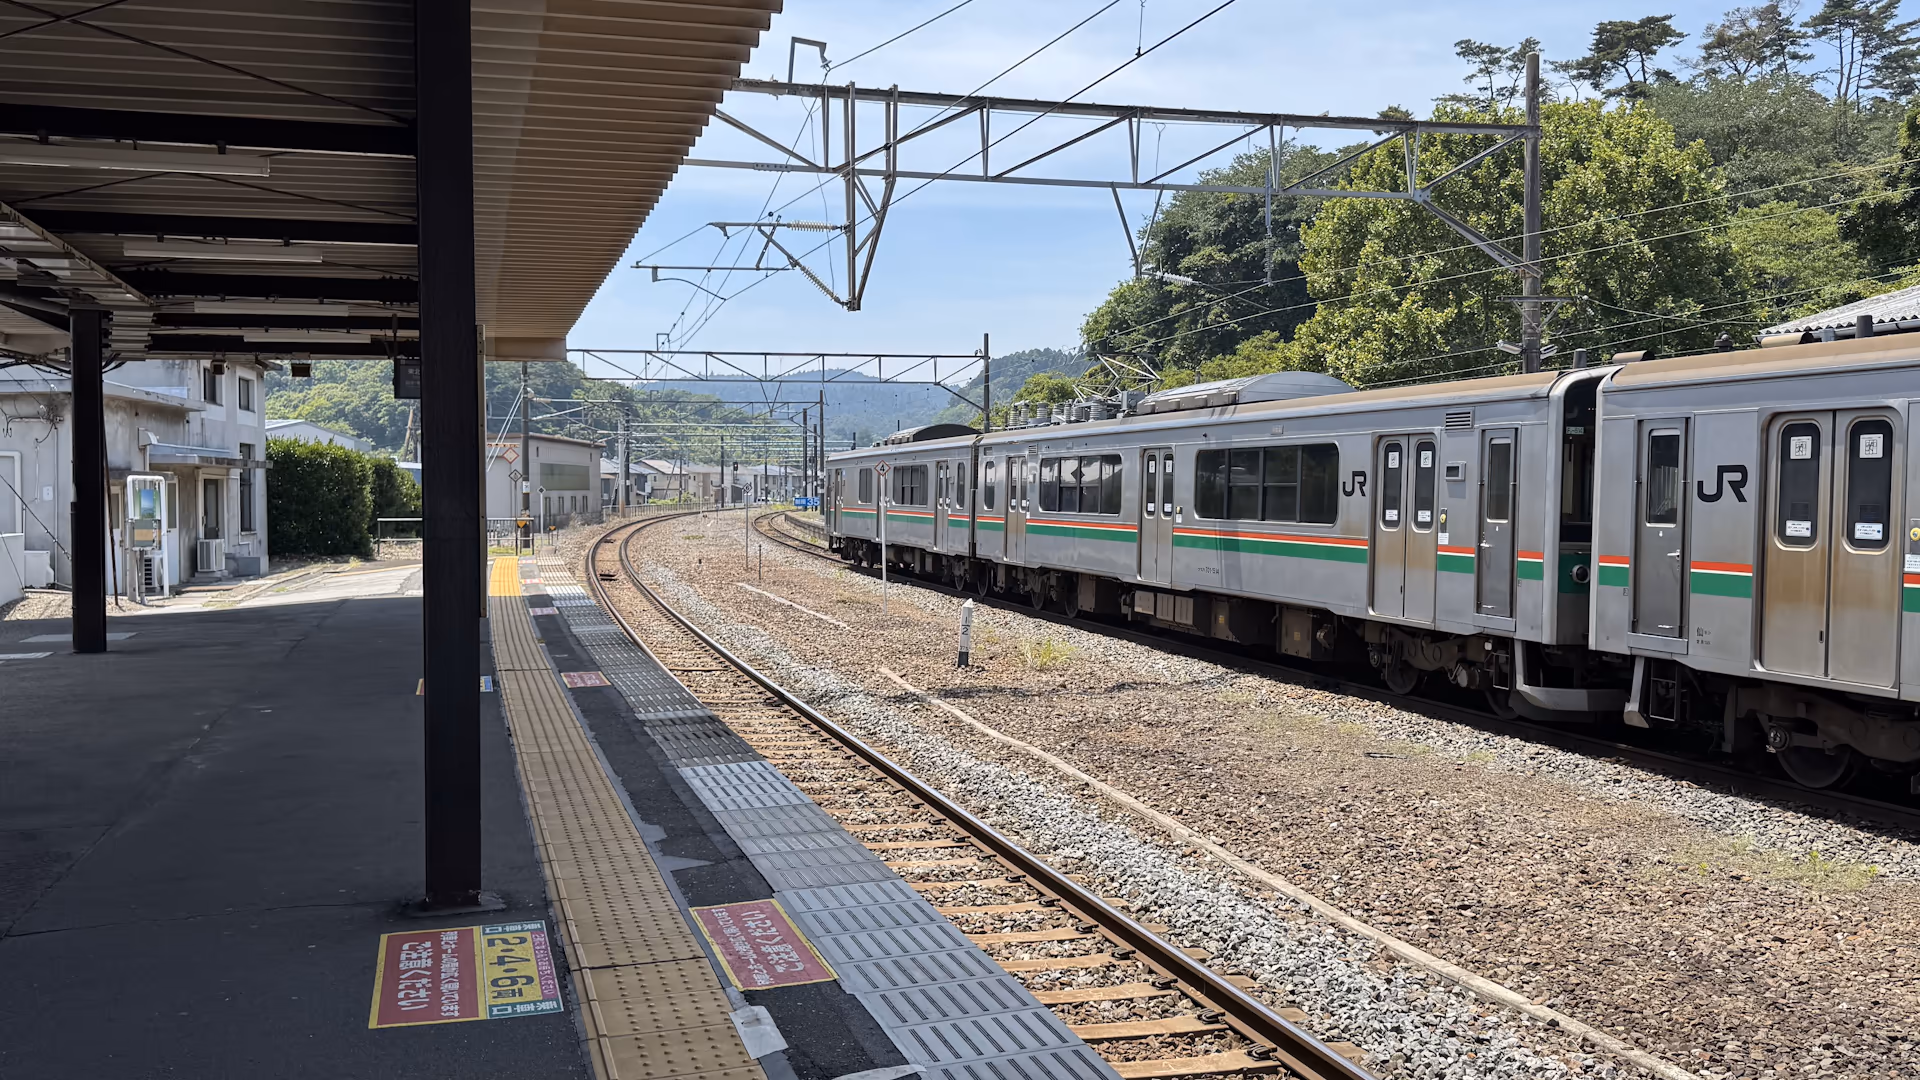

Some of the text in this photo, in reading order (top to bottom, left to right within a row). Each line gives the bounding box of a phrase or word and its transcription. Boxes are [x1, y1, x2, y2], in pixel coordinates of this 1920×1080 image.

[880, 464, 885, 472] 4
[1342, 471, 1366, 497] JR
[1697, 465, 1748, 503] JR
[807, 498, 820, 506] 35
[485, 923, 541, 933] 乗車口
[741, 911, 804, 972] ご注意ください
[397, 941, 433, 1010] ご注意ください
[492, 1001, 557, 1014] 乗車口
